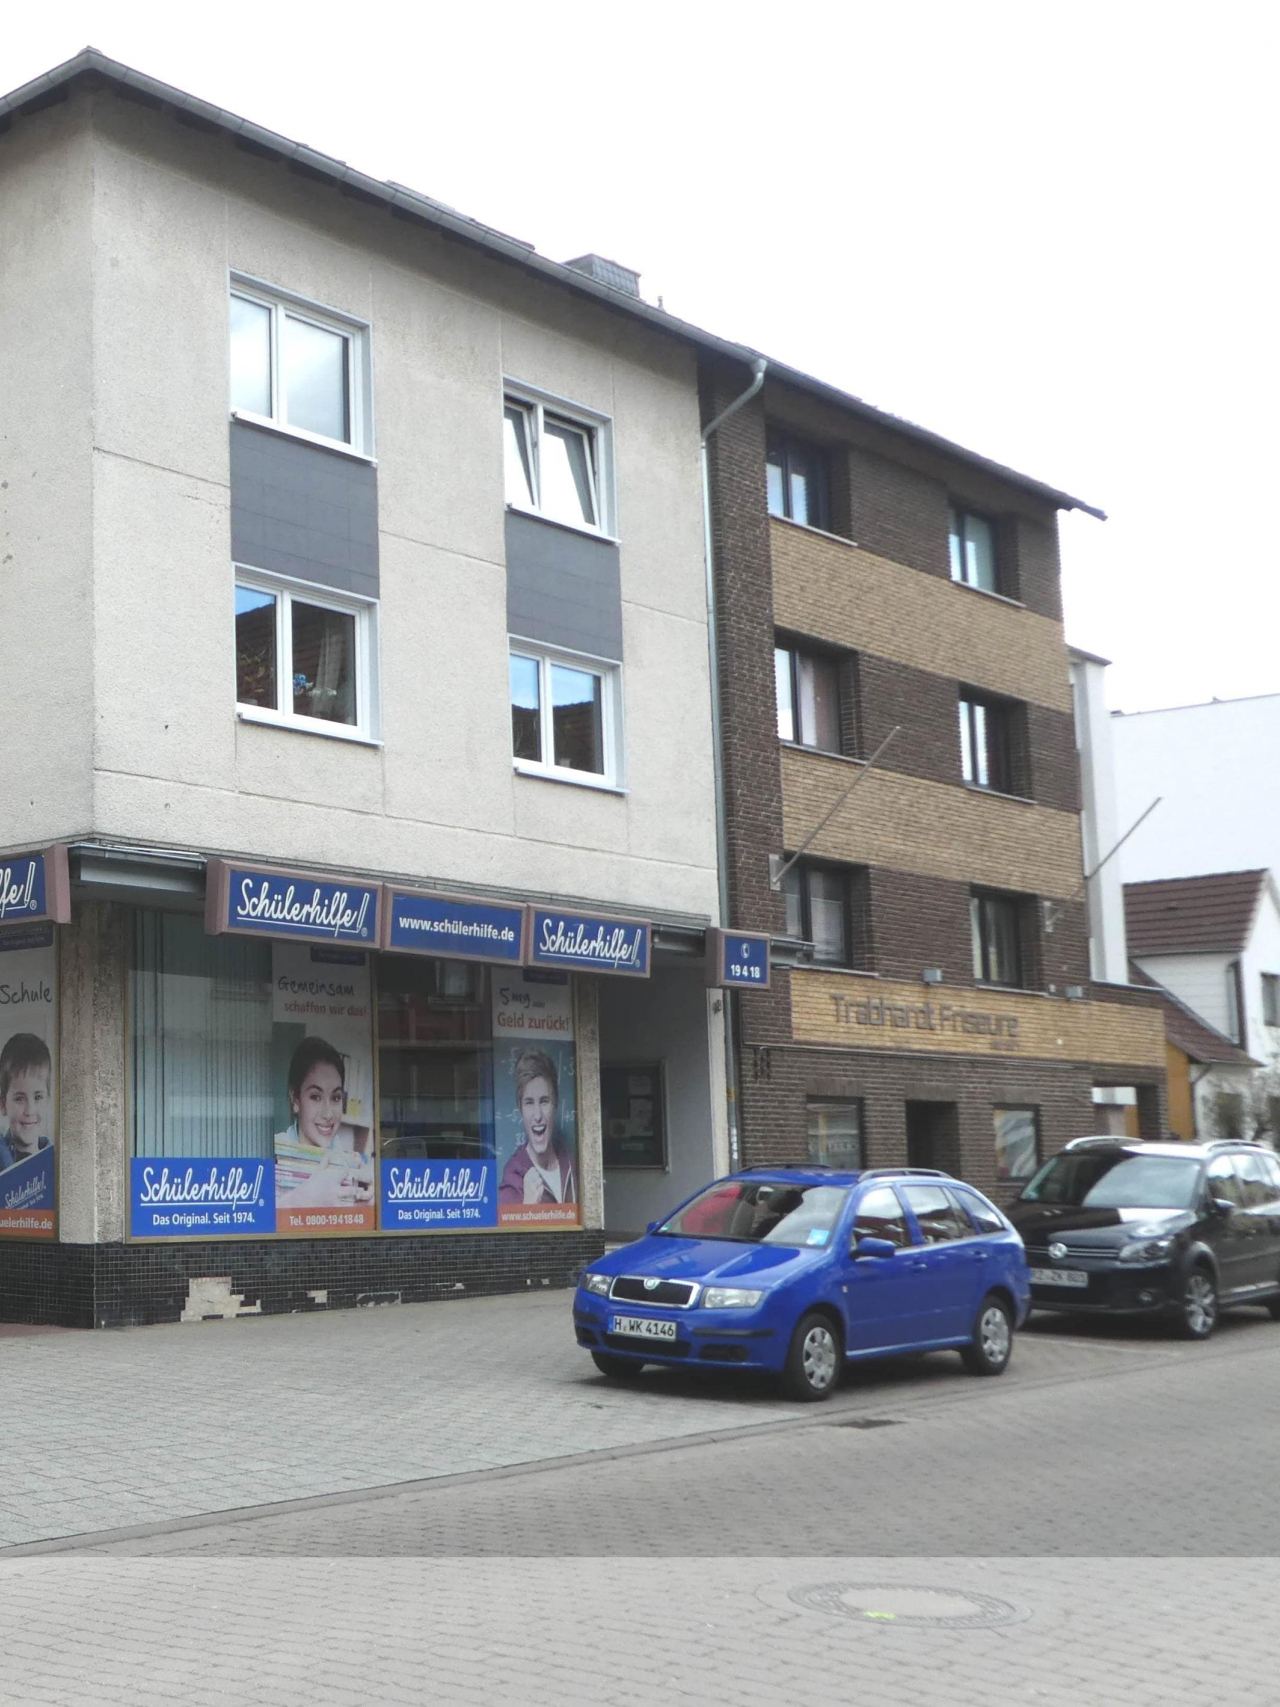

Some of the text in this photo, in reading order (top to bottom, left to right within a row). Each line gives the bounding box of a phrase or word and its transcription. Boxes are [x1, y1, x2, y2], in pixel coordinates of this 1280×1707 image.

[399, 917, 514, 941] www.schülerhilfe.de
[277, 976, 355, 996] Gemeinsam
[284, 1001, 326, 1014] schaffen
[329, 1004, 345, 1015] wir
[497, 1011, 569, 1031] Geld zurück!
[153, 1212, 255, 1227] Das Original. Seit 1974.
[289, 1215, 304, 1226] Tel.
[398, 1208, 481, 1222] Das Original. Seit 1974.
[501, 1209, 576, 1221] www.schuelerhilfe.de
[645, 1322, 674, 1337] 4146
